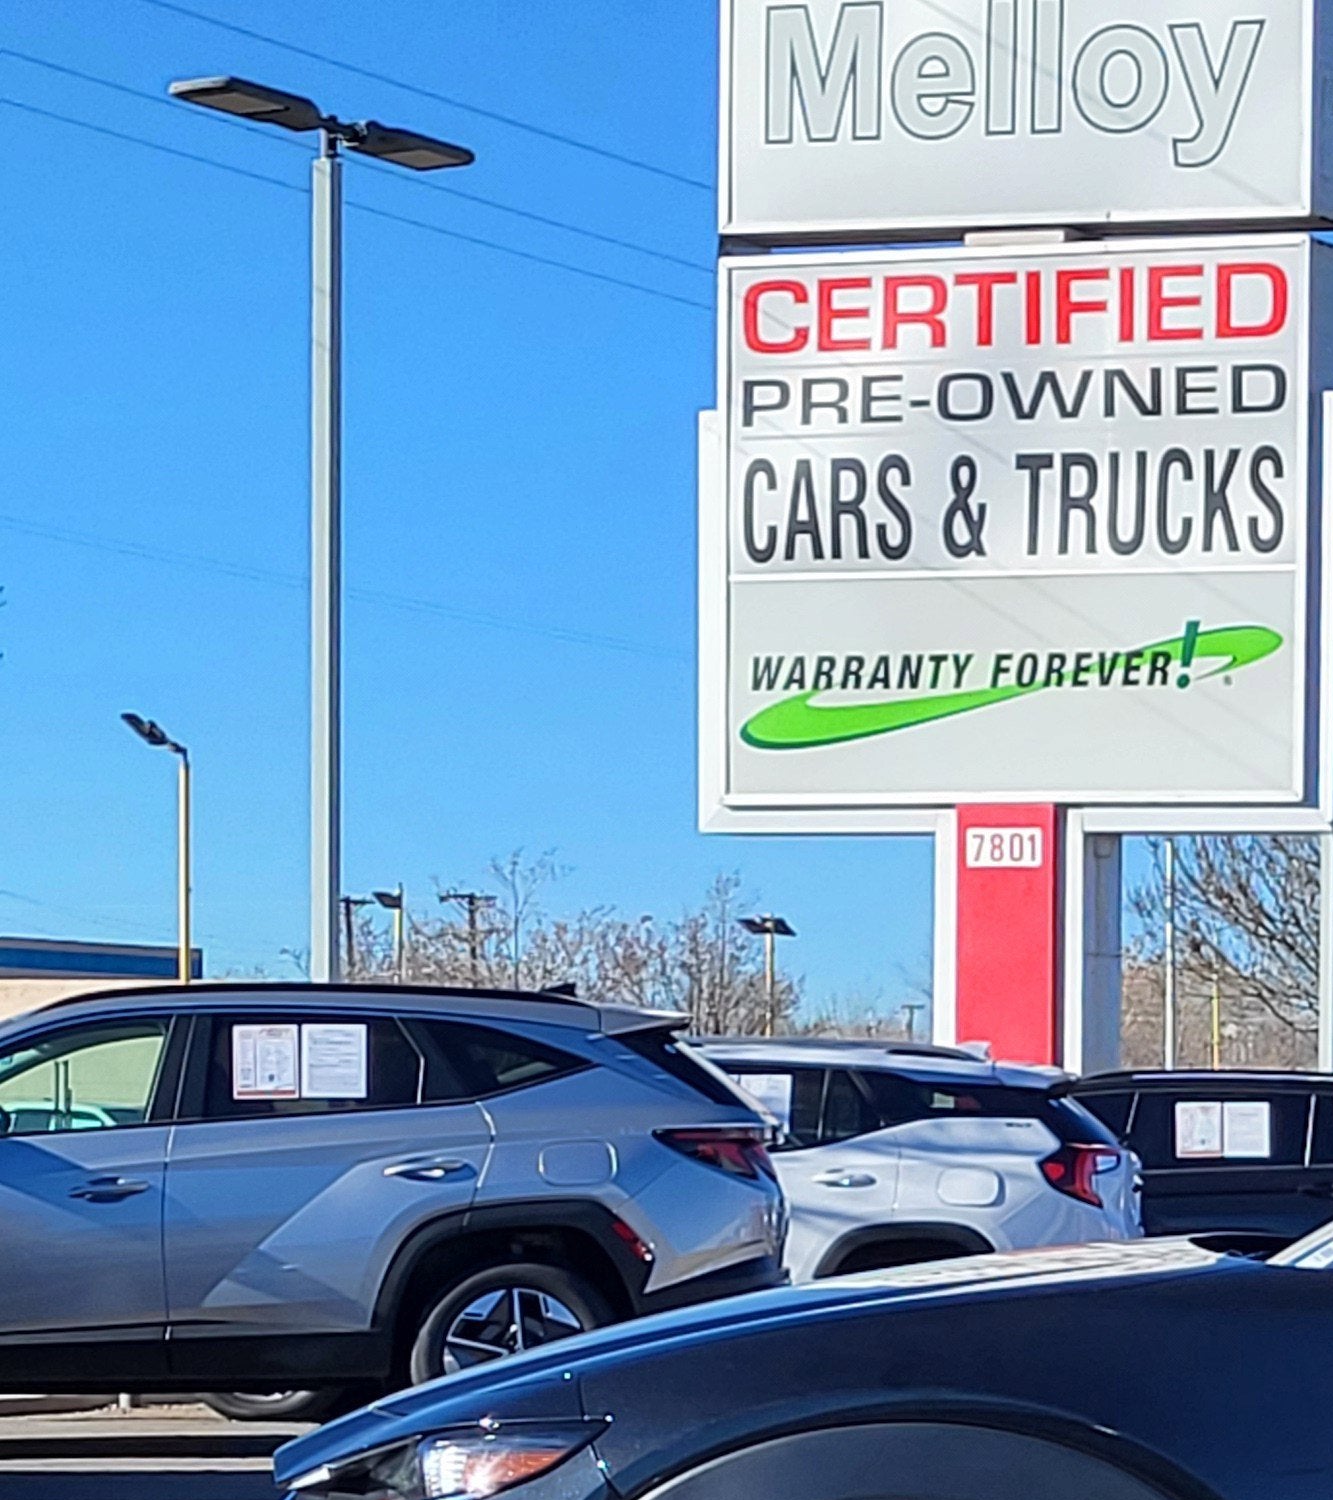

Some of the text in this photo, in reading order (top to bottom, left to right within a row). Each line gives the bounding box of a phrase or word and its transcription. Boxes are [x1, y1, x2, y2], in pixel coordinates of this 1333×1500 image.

[764, 0, 1267, 168] Melloy
[742, 261, 1289, 354] CERTIFIED
[742, 364, 1288, 429] PRE-OWNED
[743, 446, 1285, 564] CARS & TRUCKS
[751, 653, 974, 691] WARRANTY
[972, 832, 1036, 862] 7801
